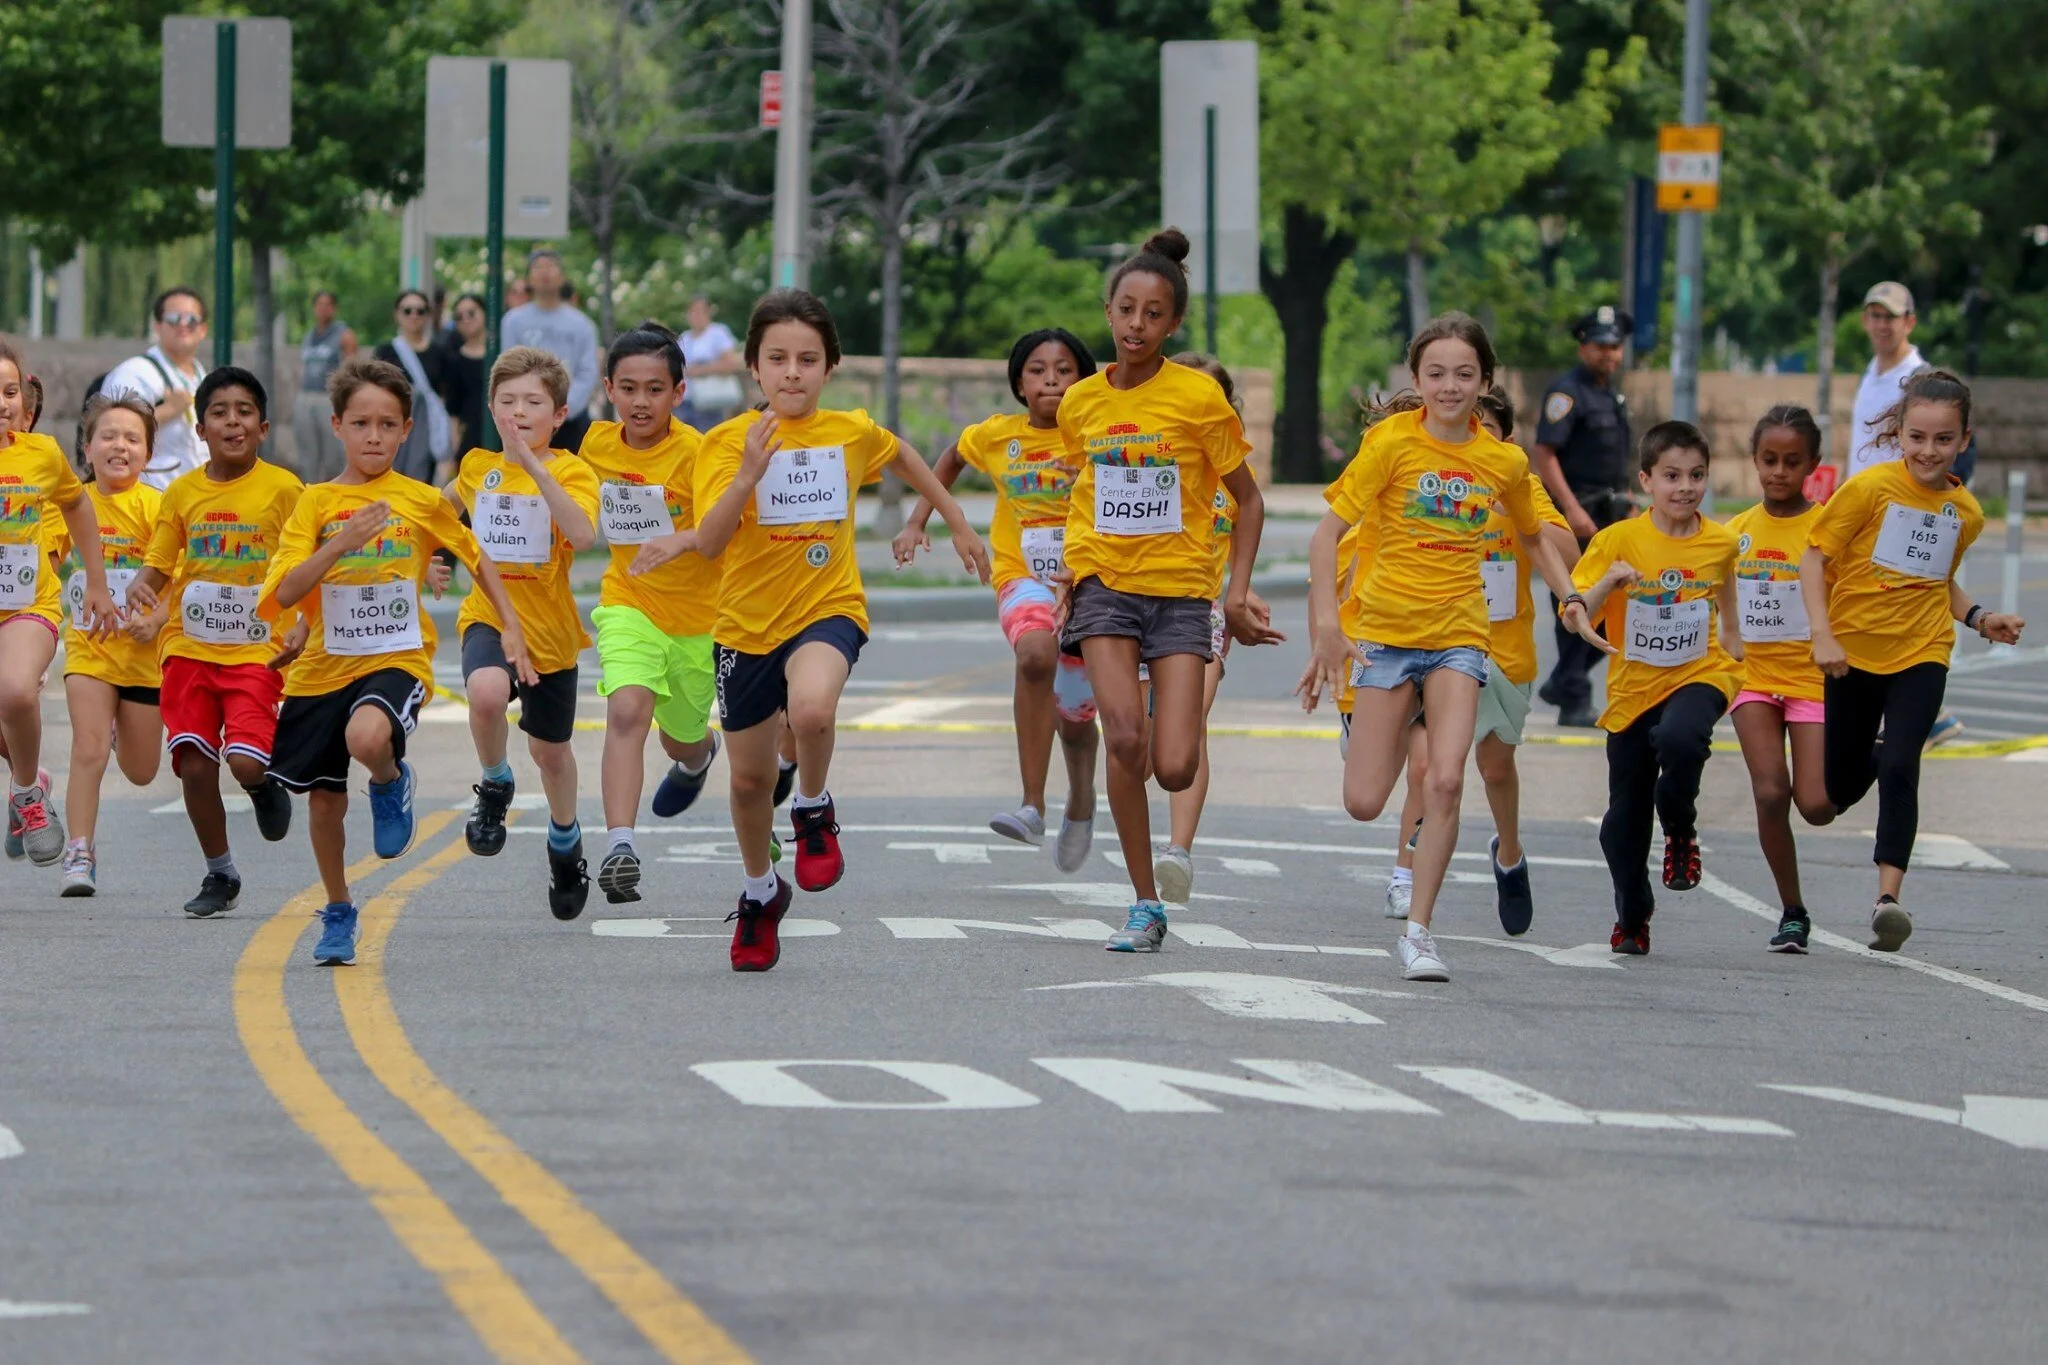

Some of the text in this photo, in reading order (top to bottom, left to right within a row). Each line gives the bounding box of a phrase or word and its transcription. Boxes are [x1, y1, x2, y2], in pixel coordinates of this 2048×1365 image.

[1090, 434, 1162, 448] WATERFRONT
[1156, 443, 1171, 454] 5K
[787, 470, 818, 485] 1617
[771, 487, 836, 506] Niccolo'
[1100, 485, 1137, 498] Center
[615, 503, 642, 514] 1595
[1102, 500, 1169, 519] DASH!
[490, 514, 520, 526] 1636
[609, 518, 660, 532] Joaquin
[190, 523, 260, 533] WATERFRONT
[396, 526, 411, 537] 5K
[252, 533, 264, 543] 5K
[483, 531, 527, 545] Julian
[1500, 537, 1513, 549] 5K
[1911, 530, 1938, 544] 1615
[1906, 545, 1932, 561] Eva
[208, 602, 244, 614] 1580
[1748, 599, 1781, 610] 1643
[350, 605, 385, 619] 1601
[206, 617, 245, 633] Elijah
[1632, 619, 1669, 633] Center
[1745, 615, 1785, 626] Rekik
[334, 622, 408, 639] Matthew
[1635, 631, 1699, 651] DASH!
[690, 1056, 2048, 1150] ONLY
